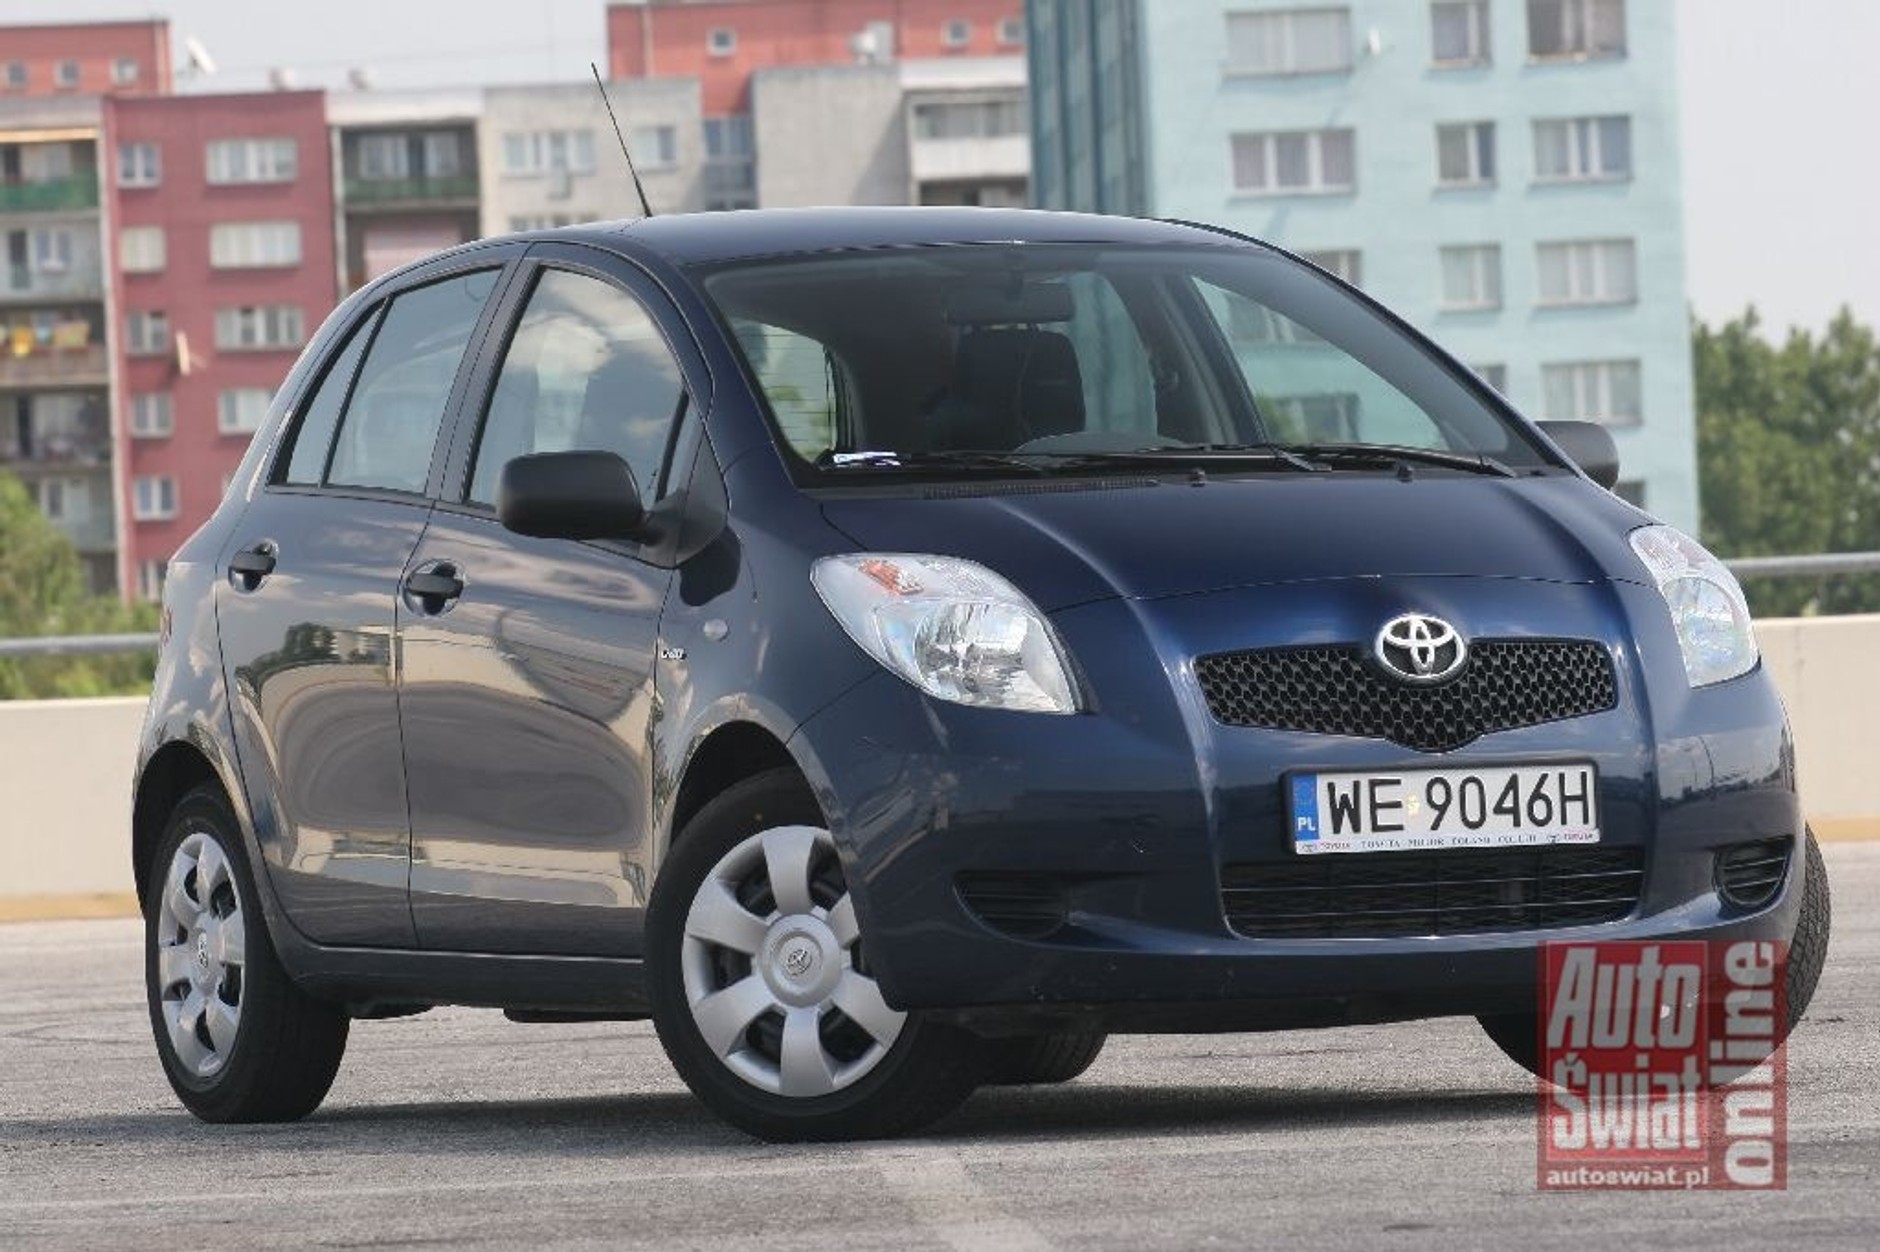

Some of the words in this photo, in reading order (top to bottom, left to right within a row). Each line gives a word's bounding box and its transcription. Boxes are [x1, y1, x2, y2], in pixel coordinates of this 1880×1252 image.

[1327, 779, 1405, 835] WE
[1425, 771, 1590, 831] 9046H
[1298, 816, 1316, 831] PL
